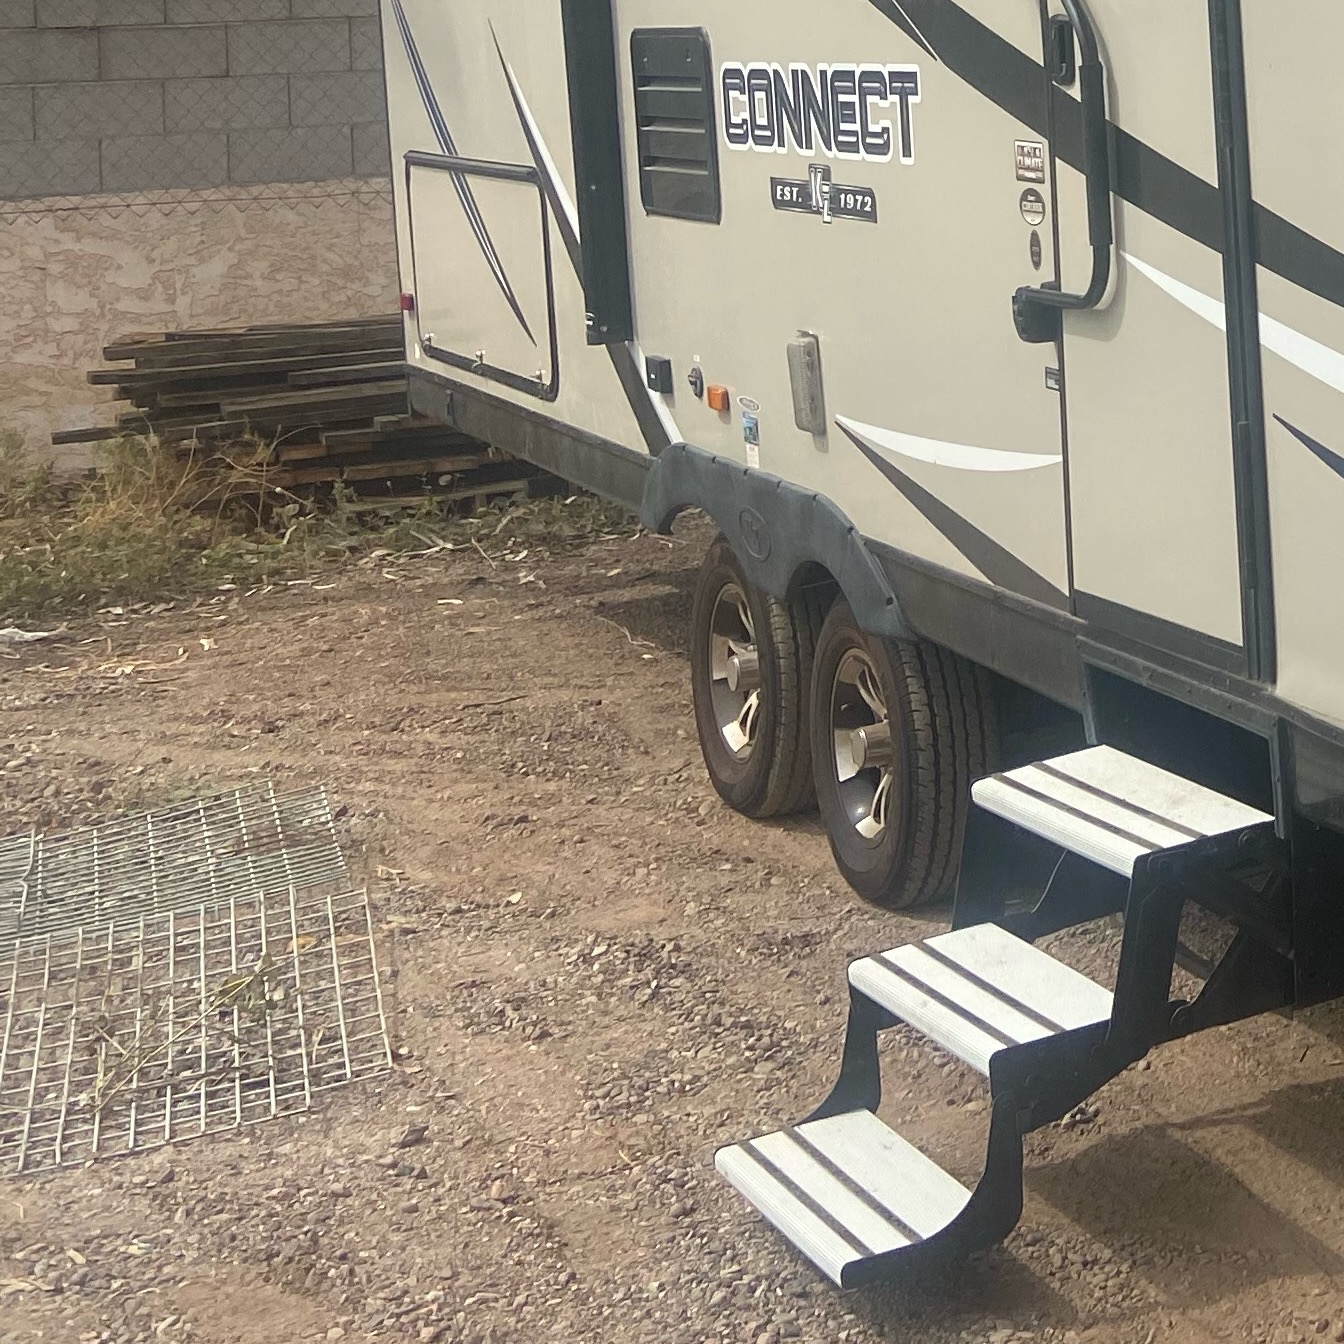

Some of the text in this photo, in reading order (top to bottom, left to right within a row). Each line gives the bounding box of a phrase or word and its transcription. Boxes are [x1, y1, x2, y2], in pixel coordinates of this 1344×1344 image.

[721, 64, 921, 164] CONNECT
[776, 185, 872, 212] EST. 1972
